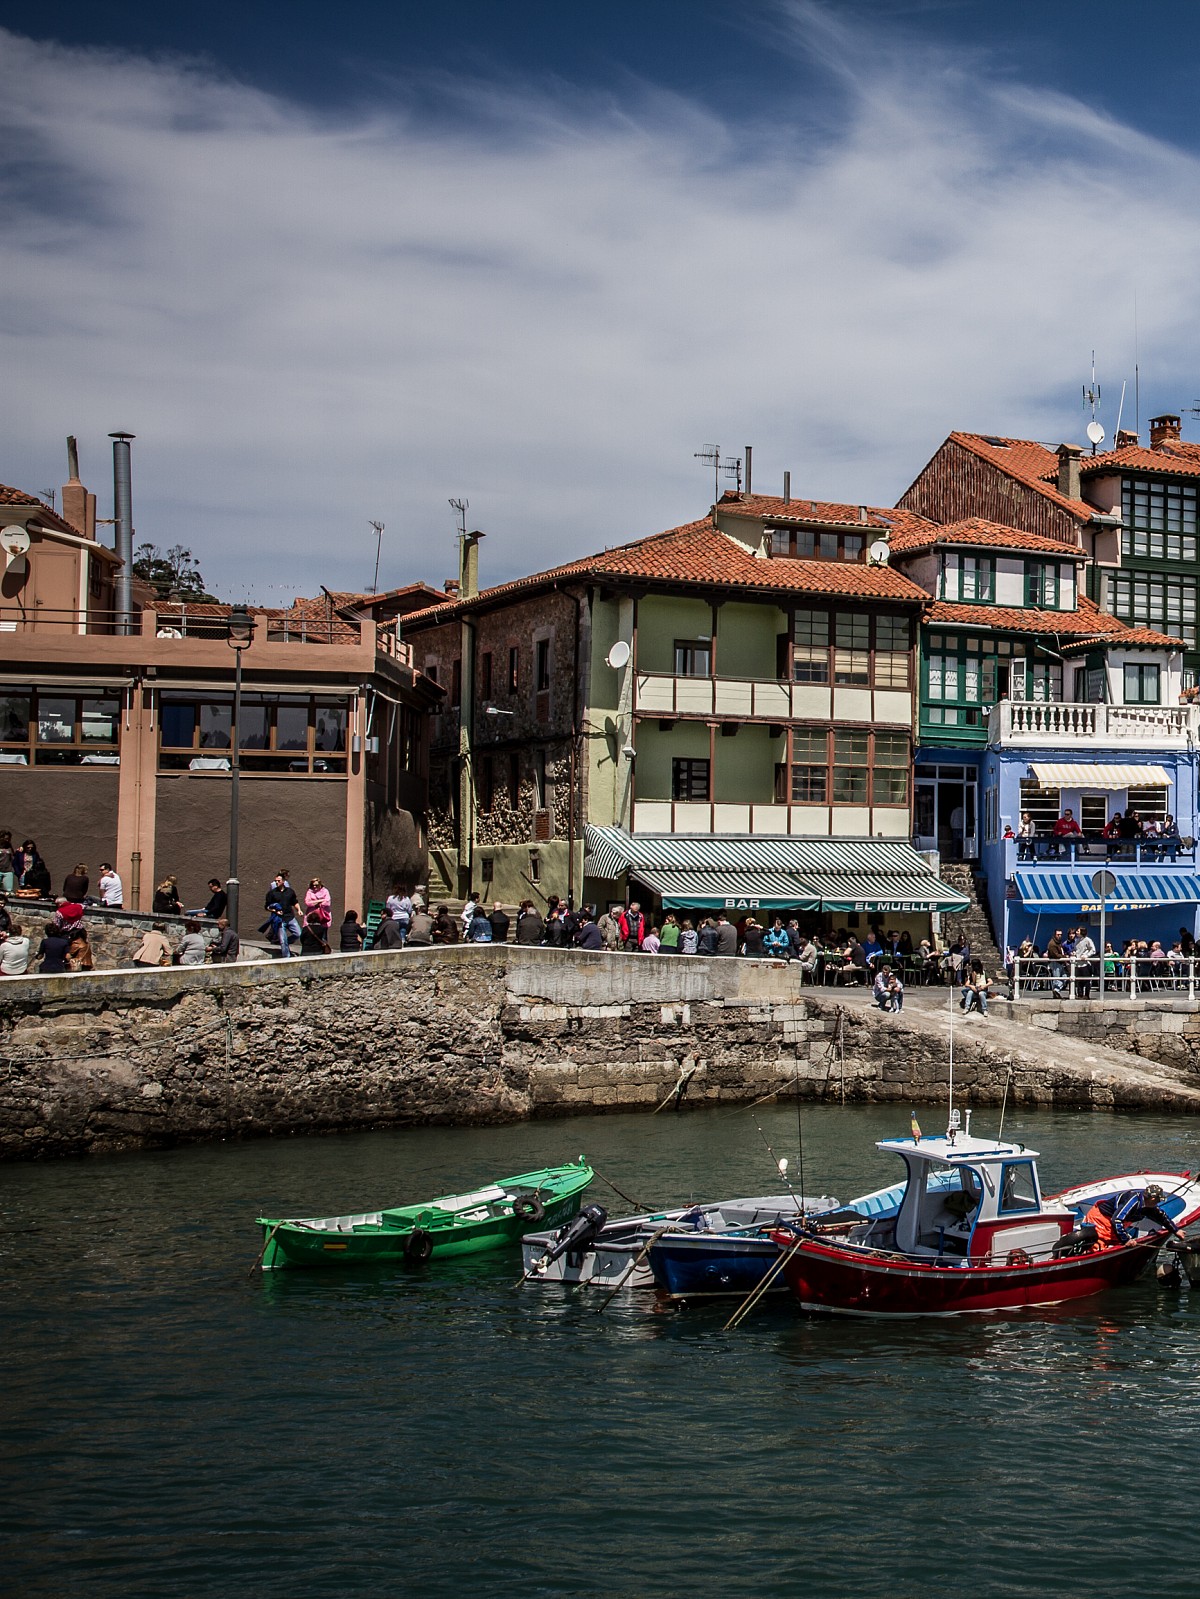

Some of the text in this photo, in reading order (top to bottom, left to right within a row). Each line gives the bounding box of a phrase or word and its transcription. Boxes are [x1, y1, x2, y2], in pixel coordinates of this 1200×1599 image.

[724, 898, 761, 909] BAR
[854, 901, 938, 912] EL MUELLE
